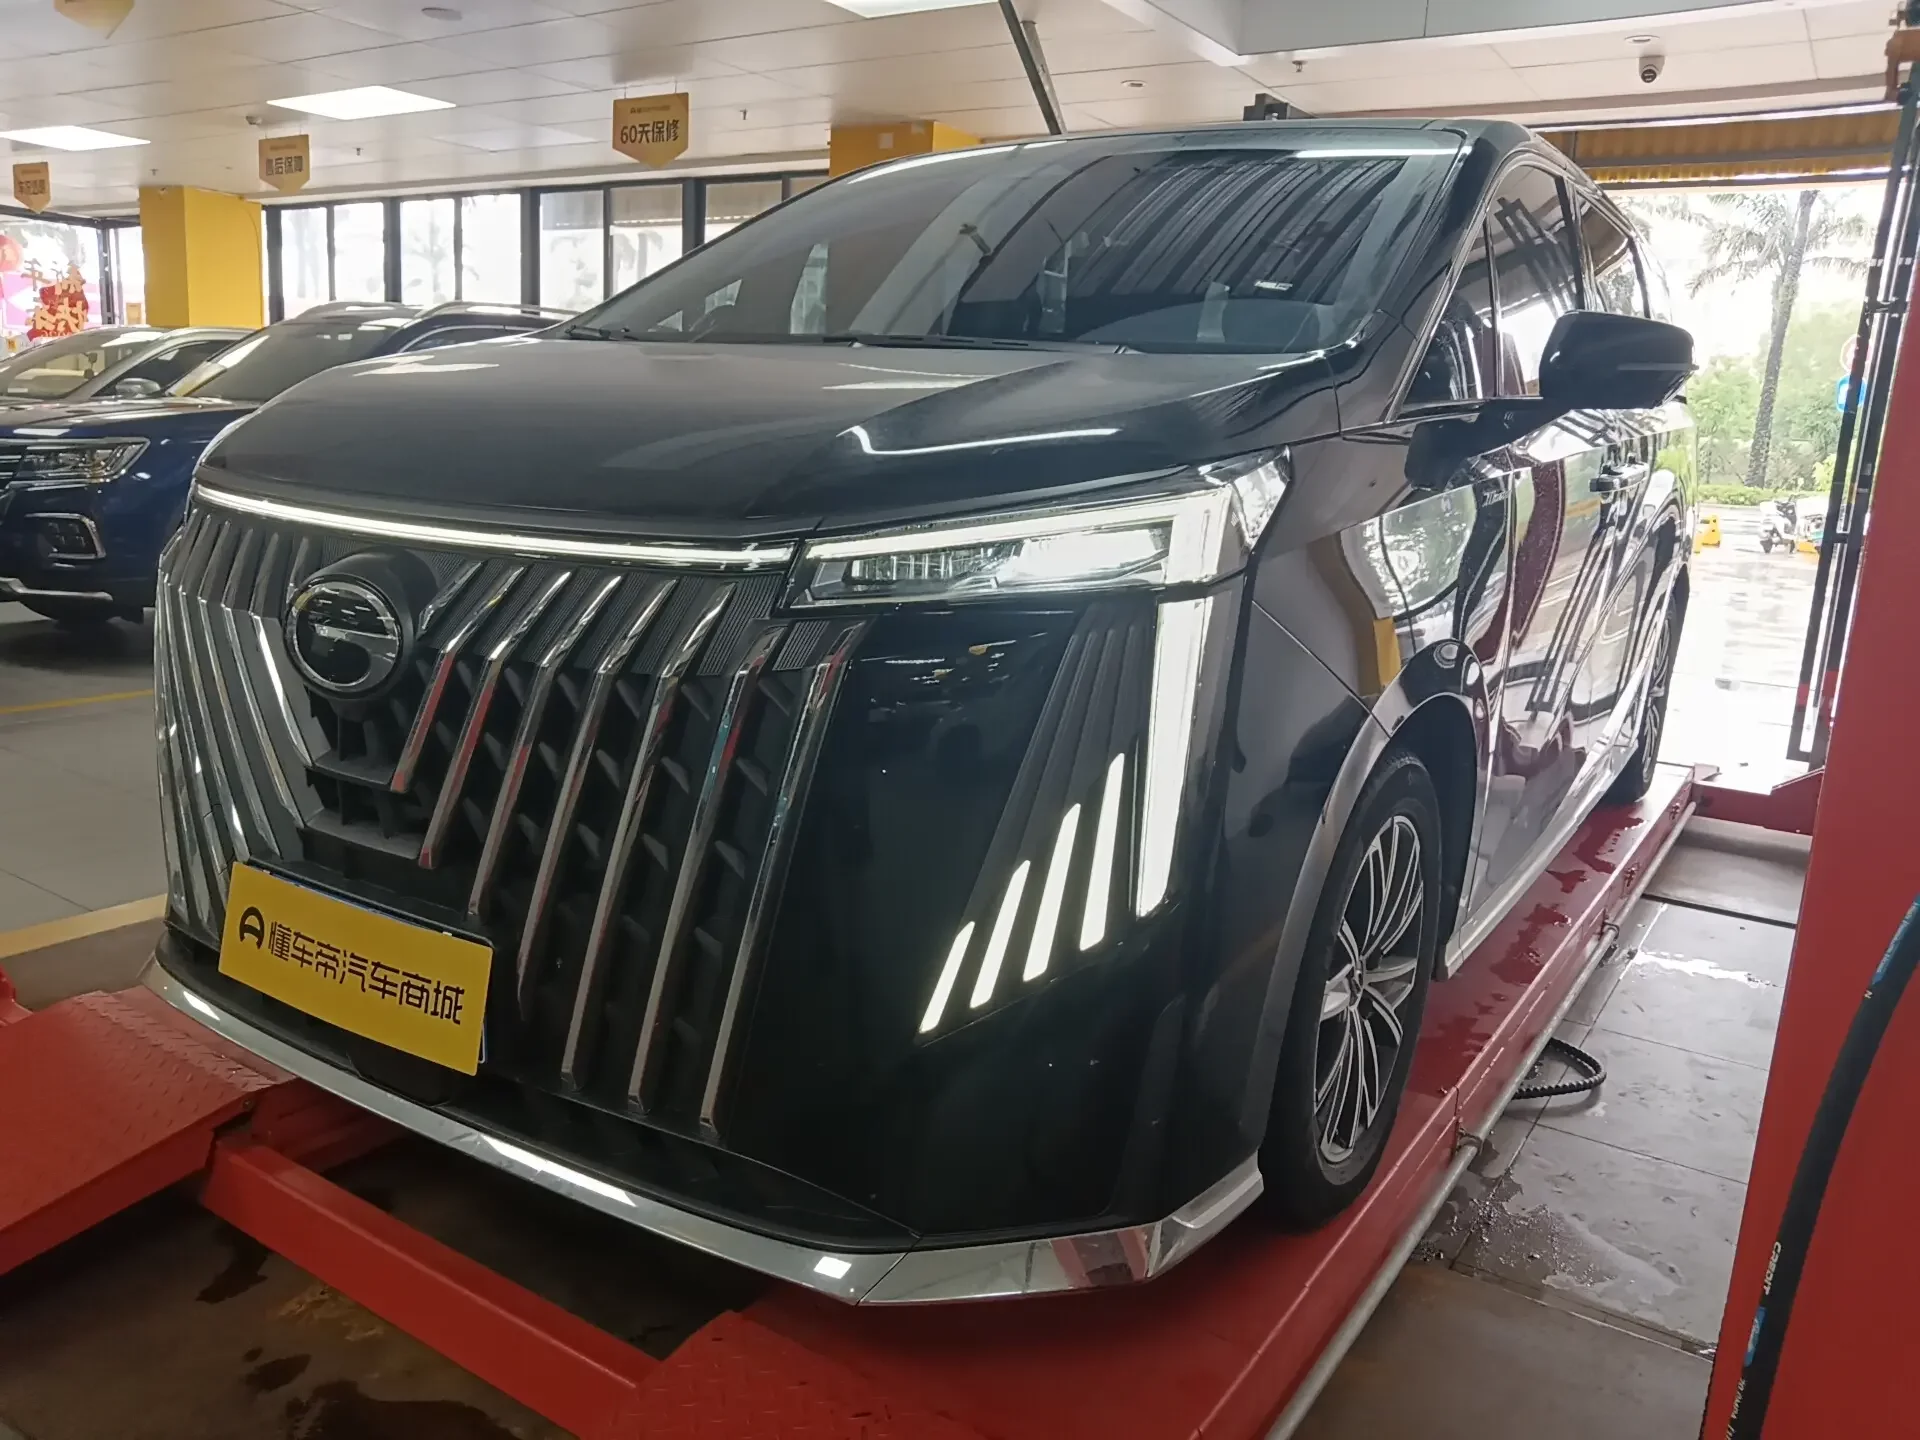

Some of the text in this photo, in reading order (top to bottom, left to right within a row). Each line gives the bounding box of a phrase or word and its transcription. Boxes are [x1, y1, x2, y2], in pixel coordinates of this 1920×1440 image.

[620, 119, 679, 144] 60天保修
[268, 921, 465, 1025] 懂车帝汽车商城
